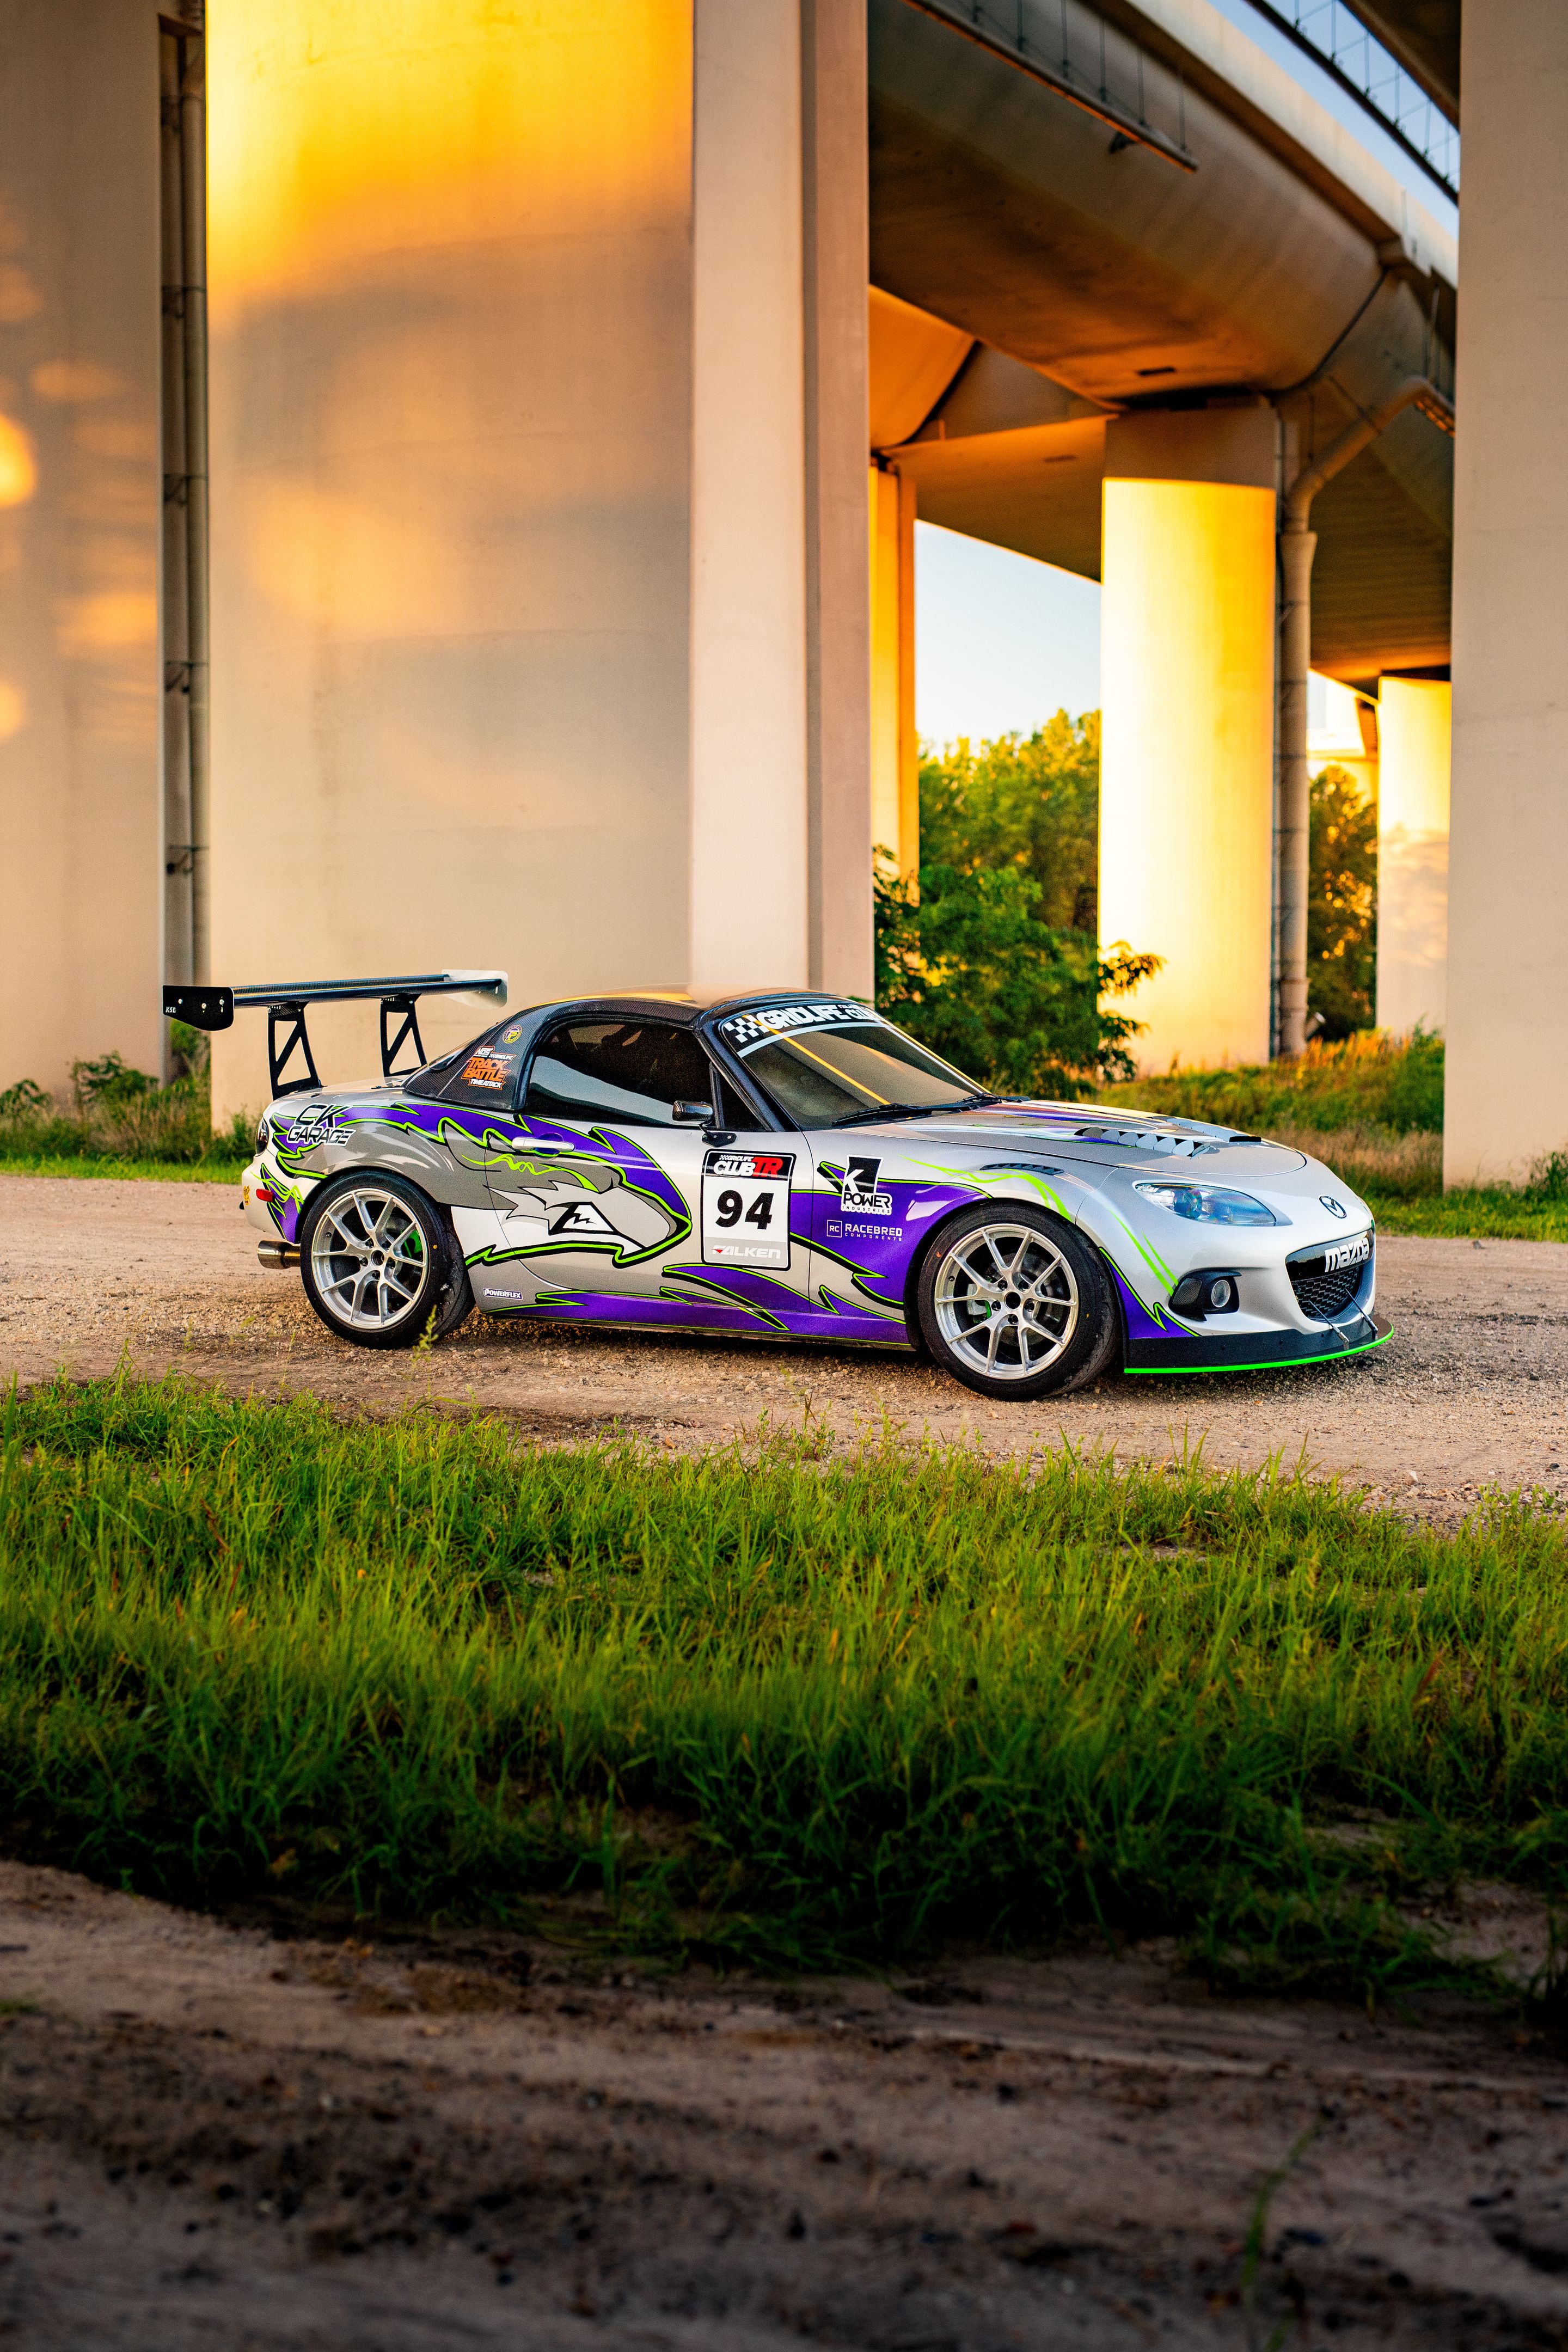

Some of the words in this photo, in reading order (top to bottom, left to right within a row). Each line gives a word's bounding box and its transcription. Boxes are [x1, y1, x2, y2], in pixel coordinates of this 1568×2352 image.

[756, 1004, 852, 1030] GRIDLIFE
[468, 1057, 509, 1070] TRACK
[463, 1068, 509, 1082] BATTLE
[295, 1104, 352, 1128] CK
[287, 1125, 356, 1145] GARAGE
[843, 1192, 891, 1209] POWER
[715, 1190, 774, 1230] 94
[842, 1205, 890, 1214] INDUSTRIES
[845, 1223, 902, 1236] RACEBRED
[845, 1232, 902, 1241] COMPONENTS
[711, 1245, 781, 1259] FALKEN
[484, 1289, 521, 1298] POWERFLEX
